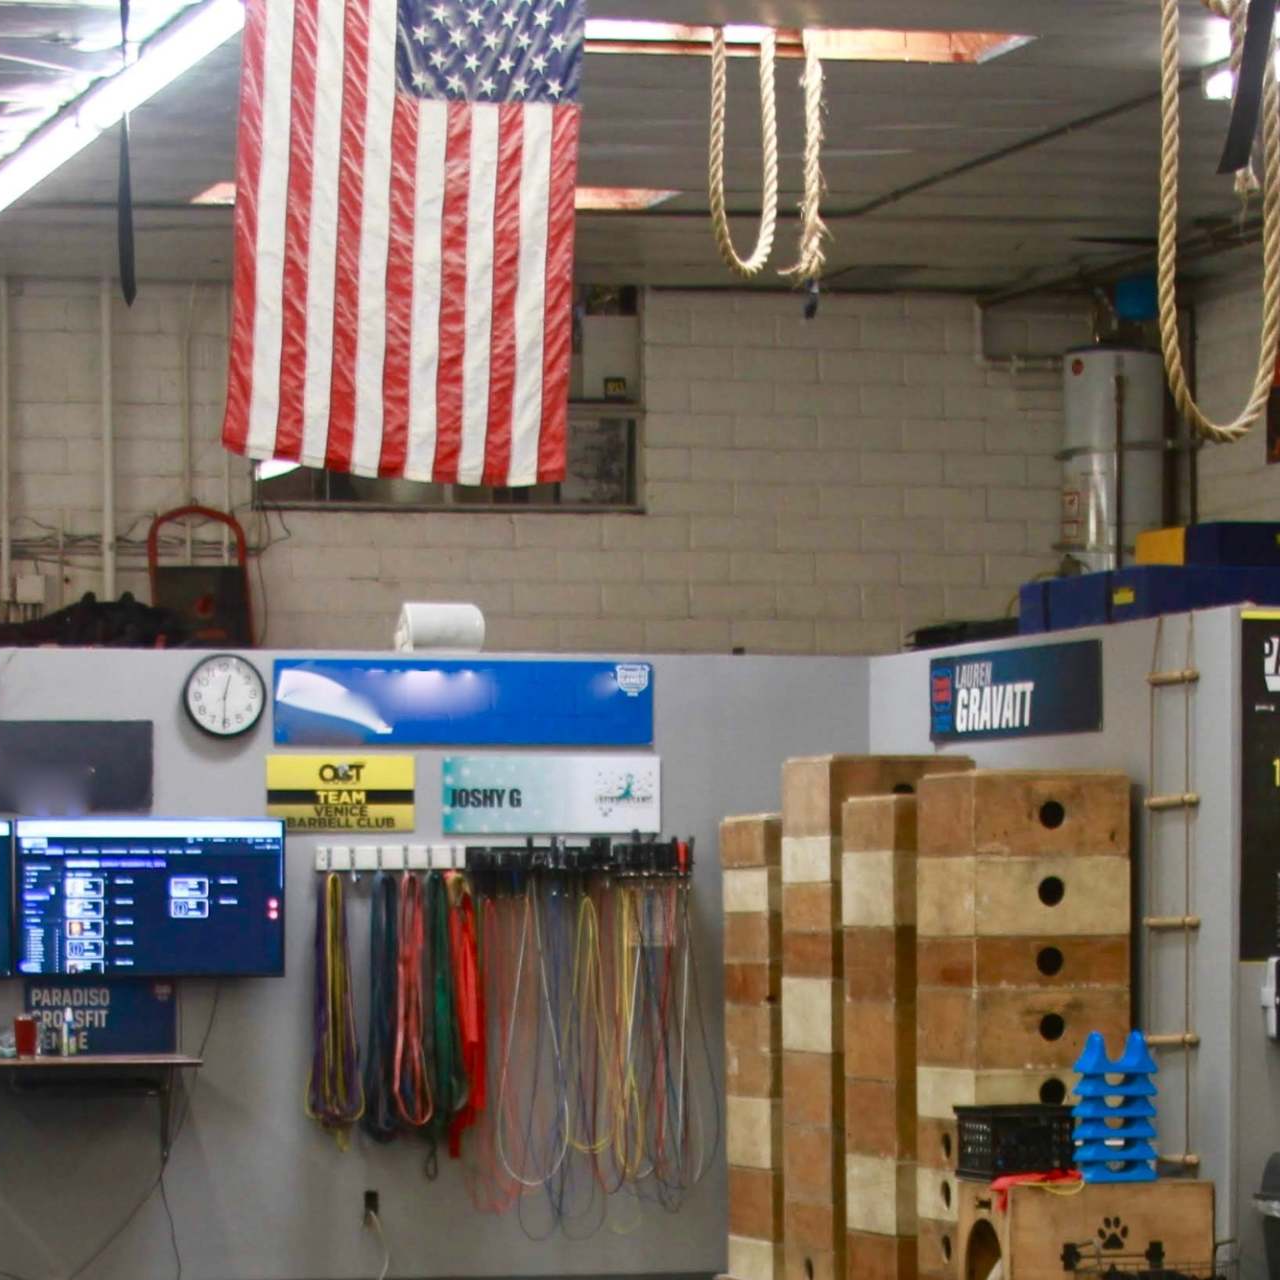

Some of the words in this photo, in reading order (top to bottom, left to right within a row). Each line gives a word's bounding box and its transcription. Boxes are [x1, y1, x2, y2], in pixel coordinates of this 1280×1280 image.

[955, 661, 992, 689] LAUREN
[956, 681, 1034, 733] GRAVATT
[316, 790, 365, 804] TEAM
[450, 788, 505, 808] JOSHY
[509, 788, 522, 808] G
[313, 805, 368, 817] VENICE
[287, 817, 354, 829] BARBELL
[358, 817, 395, 829] CLUB
[31, 988, 110, 1006] PARADISO
[32, 1010, 108, 1028] ROSFIT
